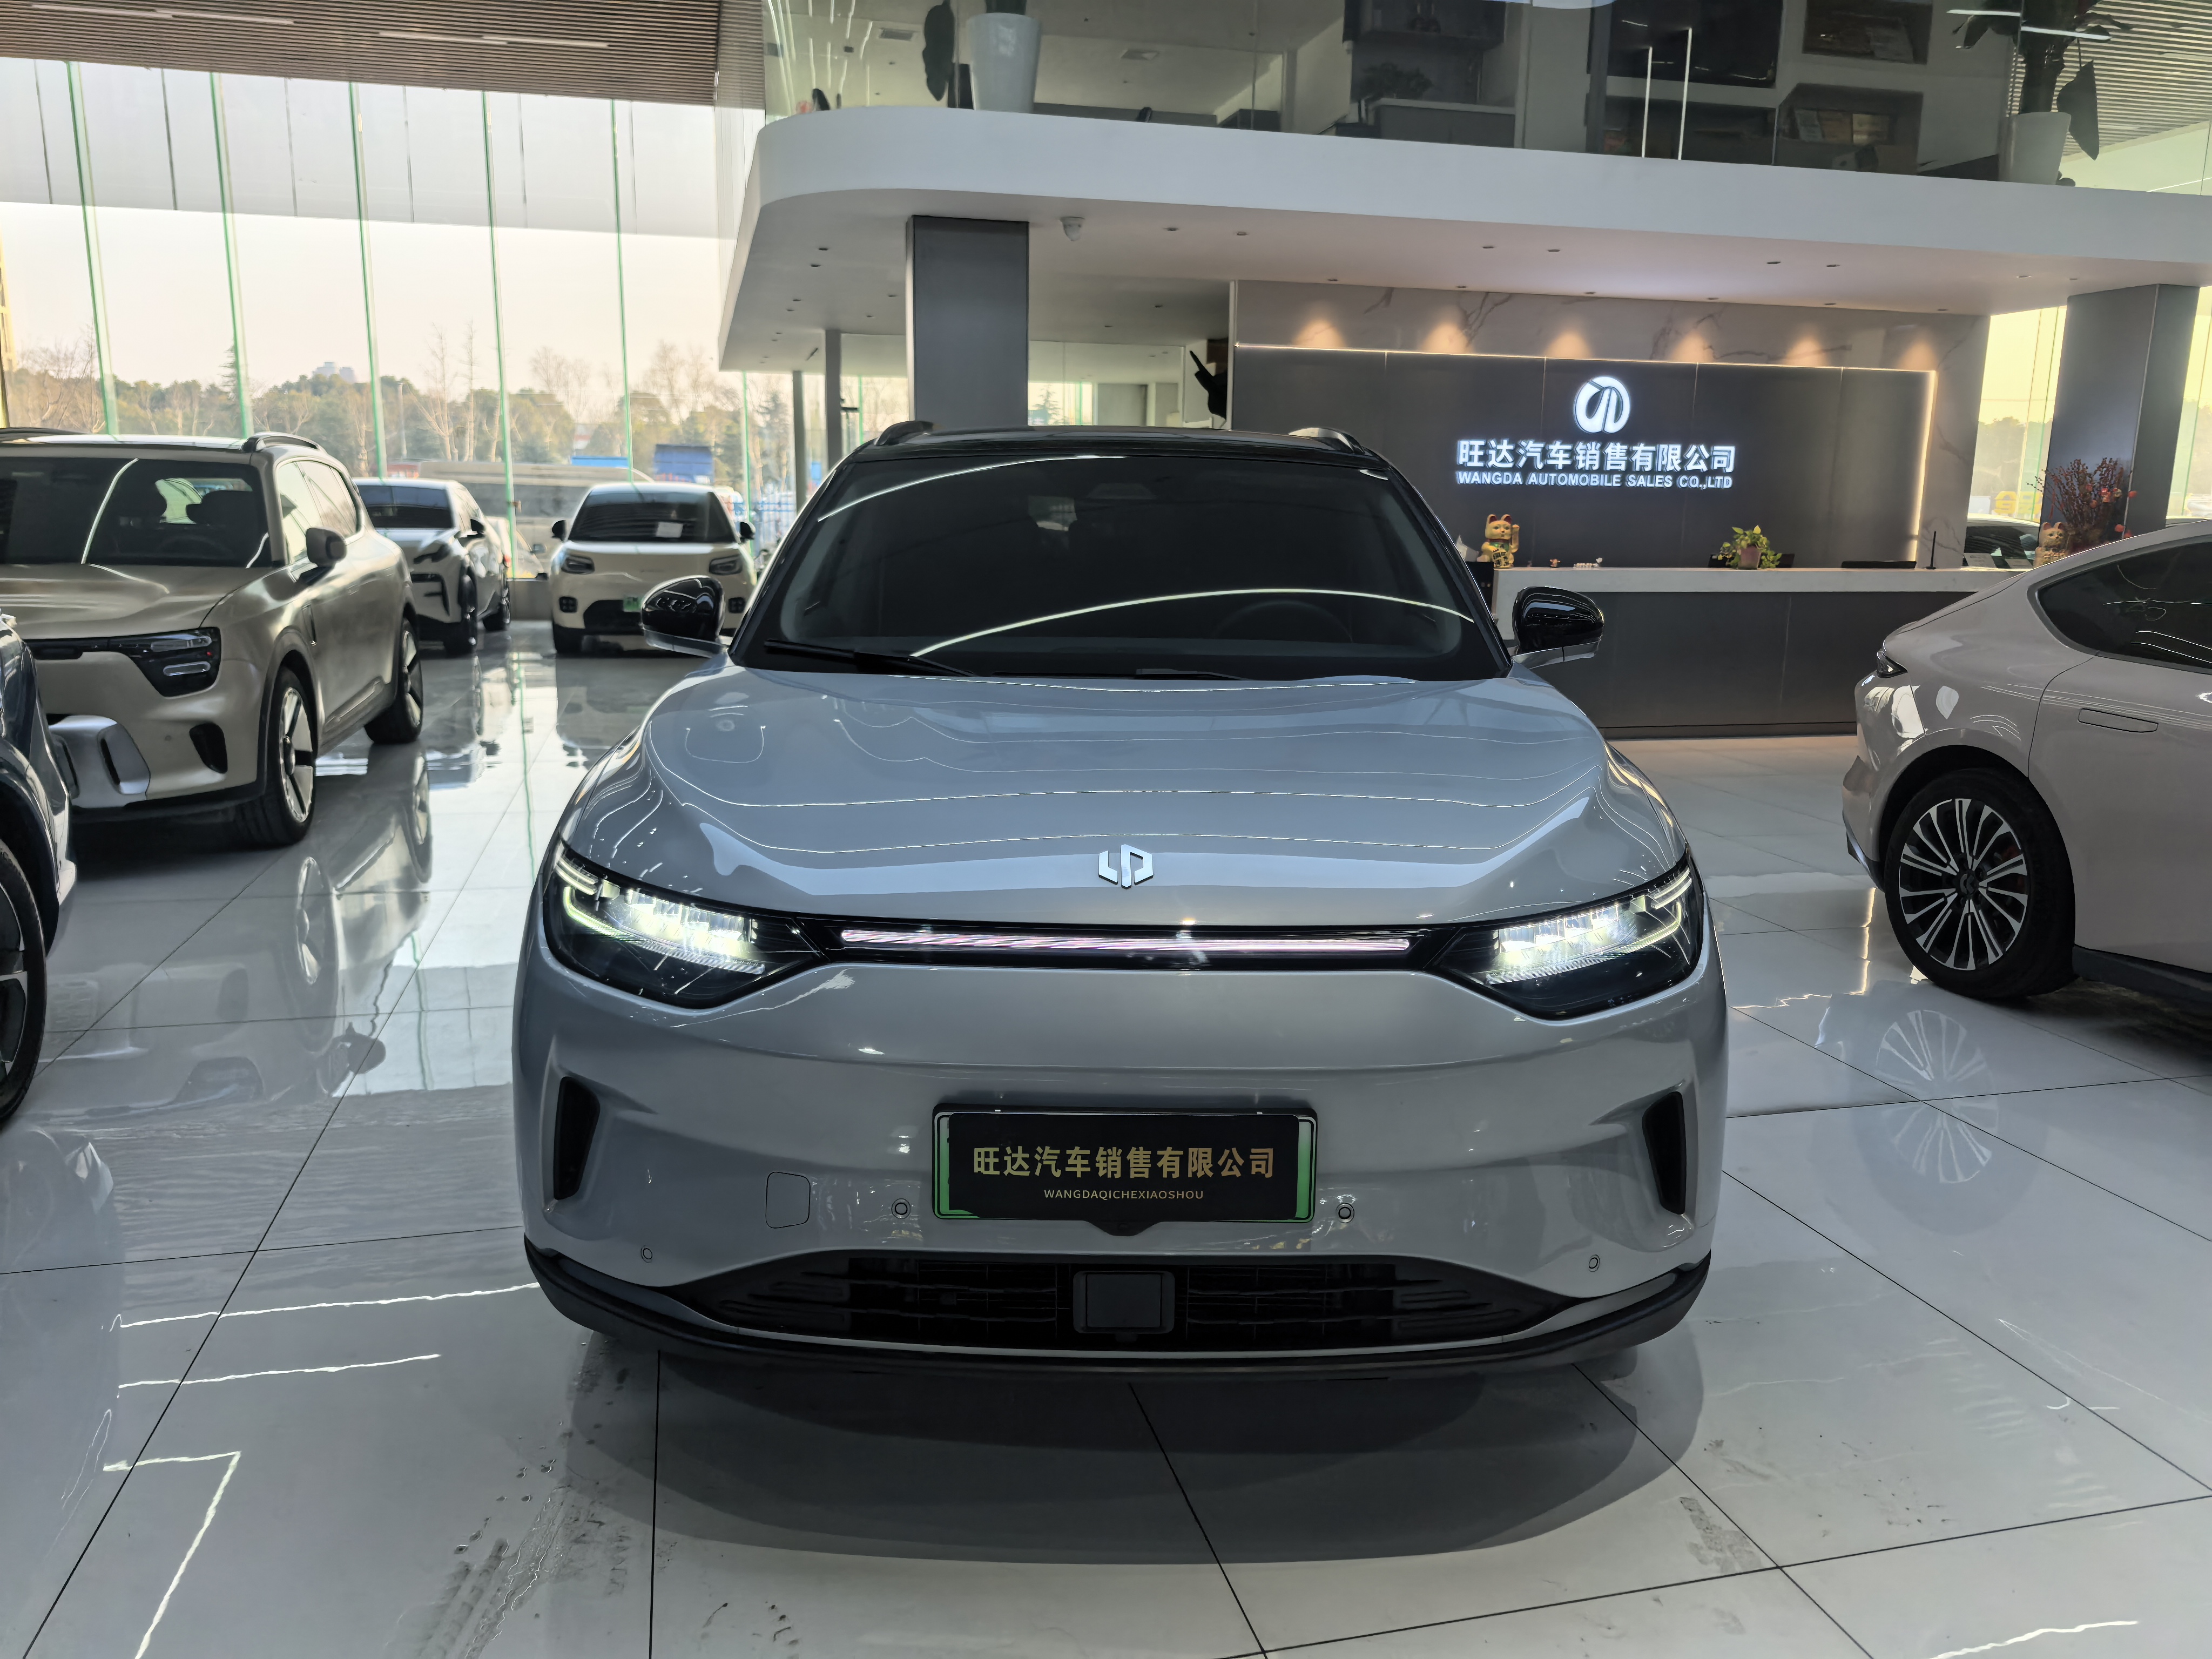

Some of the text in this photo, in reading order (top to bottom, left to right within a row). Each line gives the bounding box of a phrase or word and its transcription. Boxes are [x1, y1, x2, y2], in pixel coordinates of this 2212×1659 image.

[1458, 439, 1735, 473] 旺达汽车销售有限公司
[1457, 471, 1523, 485] WANGDA
[1527, 473, 1622, 487] AUTOMOBILE
[1626, 475, 1673, 488] SALES
[974, 1145, 1274, 1178] 旺达汽车销售有限公司
[1043, 1189, 1204, 1201] WANGDAQICHEXIAOSHOU
